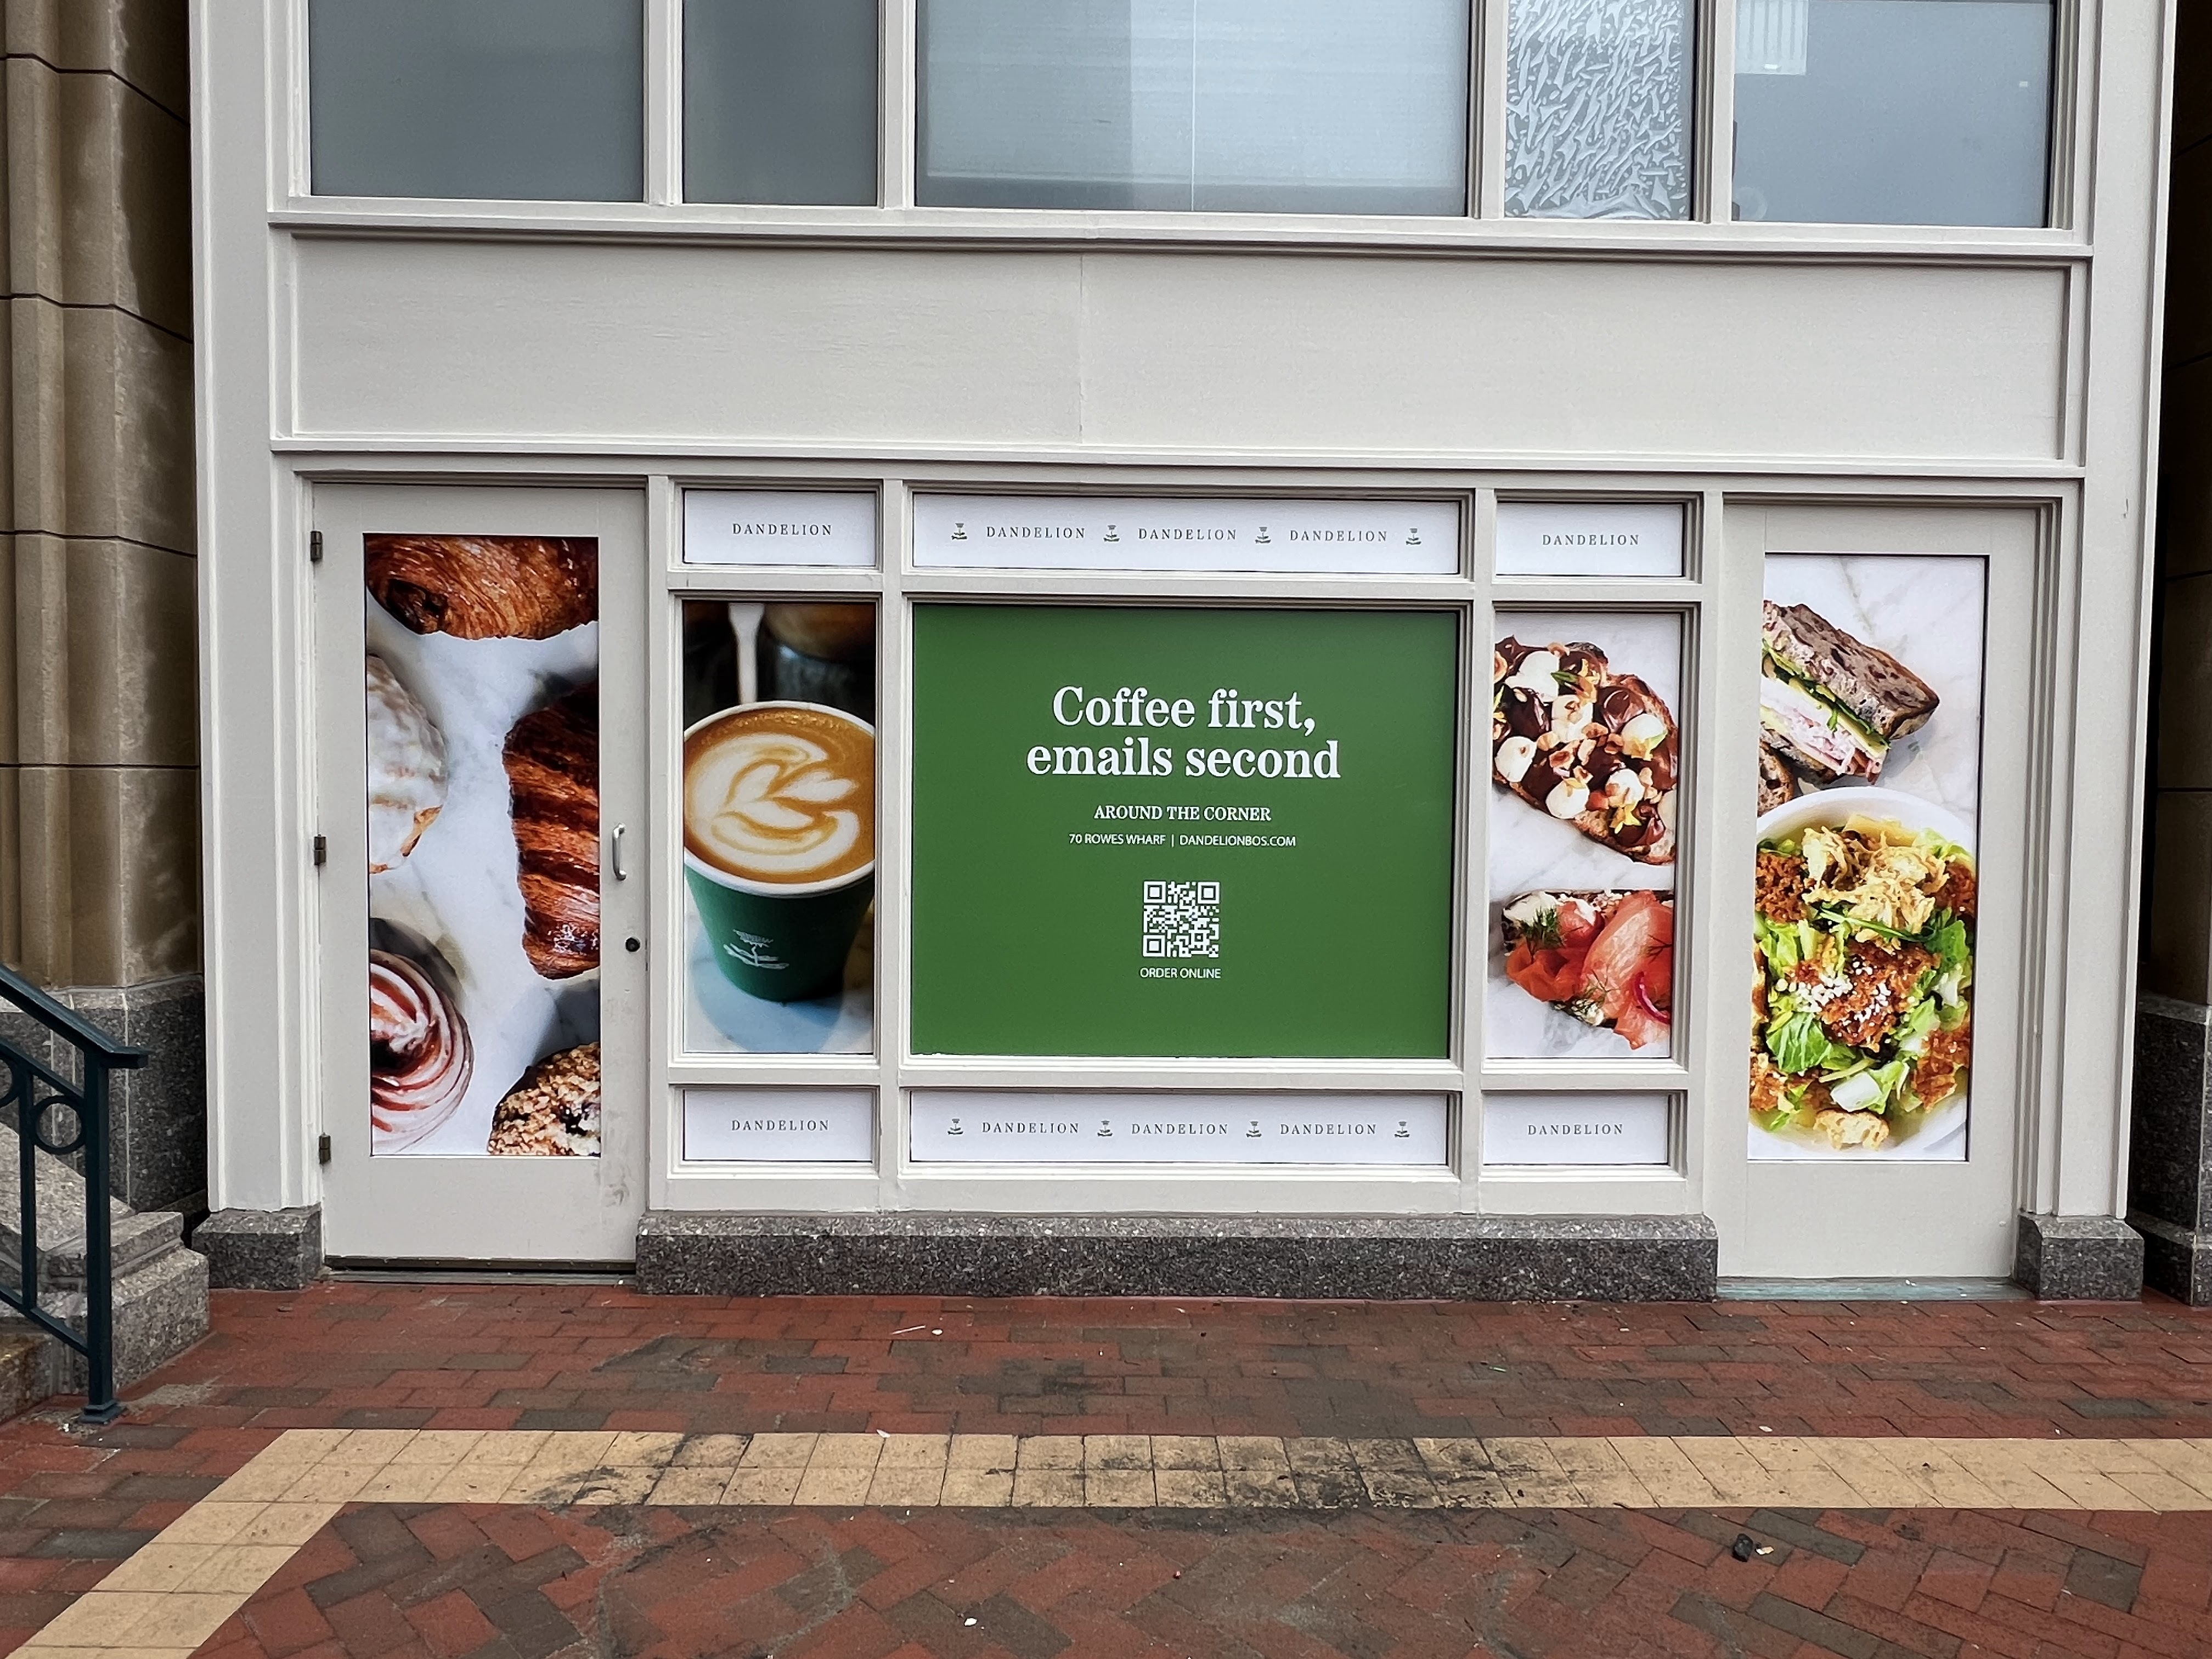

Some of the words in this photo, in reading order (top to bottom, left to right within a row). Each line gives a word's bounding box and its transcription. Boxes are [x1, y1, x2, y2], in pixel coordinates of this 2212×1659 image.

[732, 523, 831, 535] DANDELION
[986, 526, 1085, 539] DANDELION
[1138, 528, 1236, 540] DANDELION
[1290, 530, 1387, 541] DANDELION
[1543, 534, 1639, 545] DANDELION
[1053, 686, 1195, 727] Coffee
[1207, 688, 1316, 736] first,
[1027, 736, 1173, 776] emails
[1186, 740, 1341, 778] second
[1094, 805, 1163, 820] AROUND
[1166, 806, 1200, 820] THE
[1204, 806, 1272, 821] CORNER
[1069, 834, 1083, 844] 70
[1085, 833, 1124, 845] ROWES
[1125, 834, 1166, 845] WHARF
[1180, 834, 1296, 847] DANDELIONBOS.COM
[1140, 968, 1177, 979] ORDER
[1180, 968, 1221, 979] ONLINE
[732, 1119, 828, 1131] DANDELION
[982, 1122, 1079, 1133] DANDELION
[1132, 1124, 1228, 1135] DANDELION
[1280, 1124, 1376, 1135] DANDELION
[1528, 1124, 1623, 1135] DANDELION
